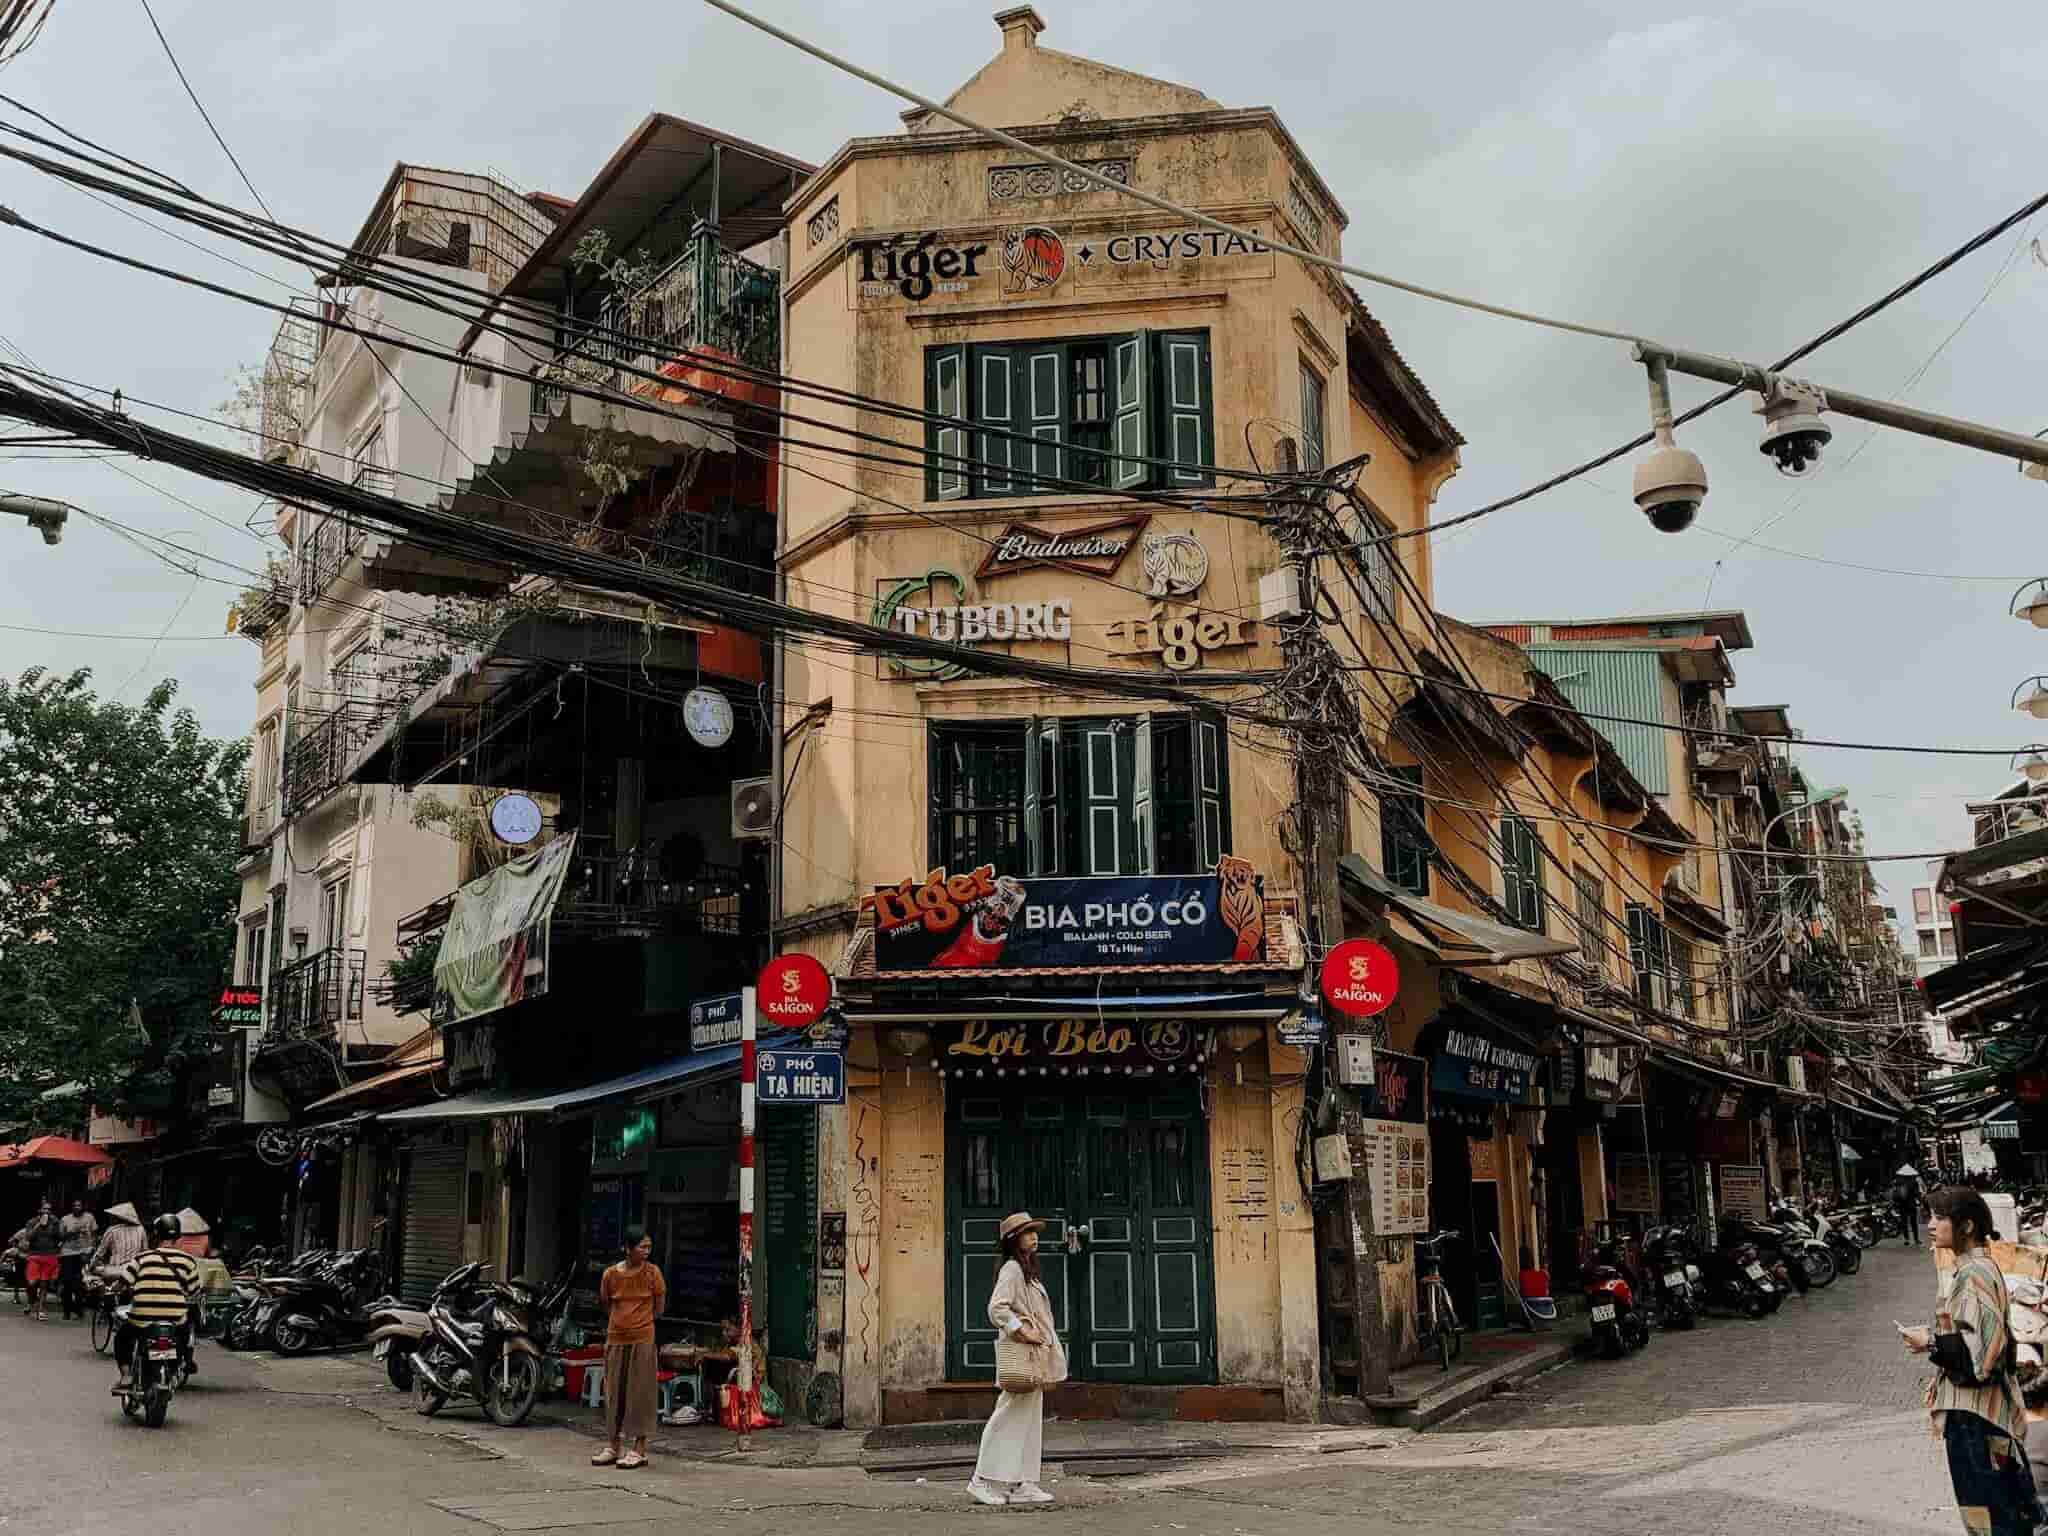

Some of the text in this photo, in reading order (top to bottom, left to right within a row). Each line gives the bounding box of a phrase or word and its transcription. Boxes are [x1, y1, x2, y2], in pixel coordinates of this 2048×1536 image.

[845, 229, 1271, 300] Tiger CRYSTAL
[994, 534, 1127, 562] Budweiser
[895, 600, 1072, 642] TUBORG
[1106, 602, 1258, 672] Tiger
[860, 863, 996, 934] Tiger
[1025, 904, 1080, 930] BIA
[1084, 893, 1154, 929] PHỐ
[1116, 931, 1144, 941] COLD
[1144, 930, 1172, 941] BEER
[768, 1001, 815, 1015] SAIGON
[1333, 987, 1382, 1003] SAIGON
[785, 1055, 816, 1071] PHỐ
[767, 1071, 834, 1098] TẠ HIỆN
